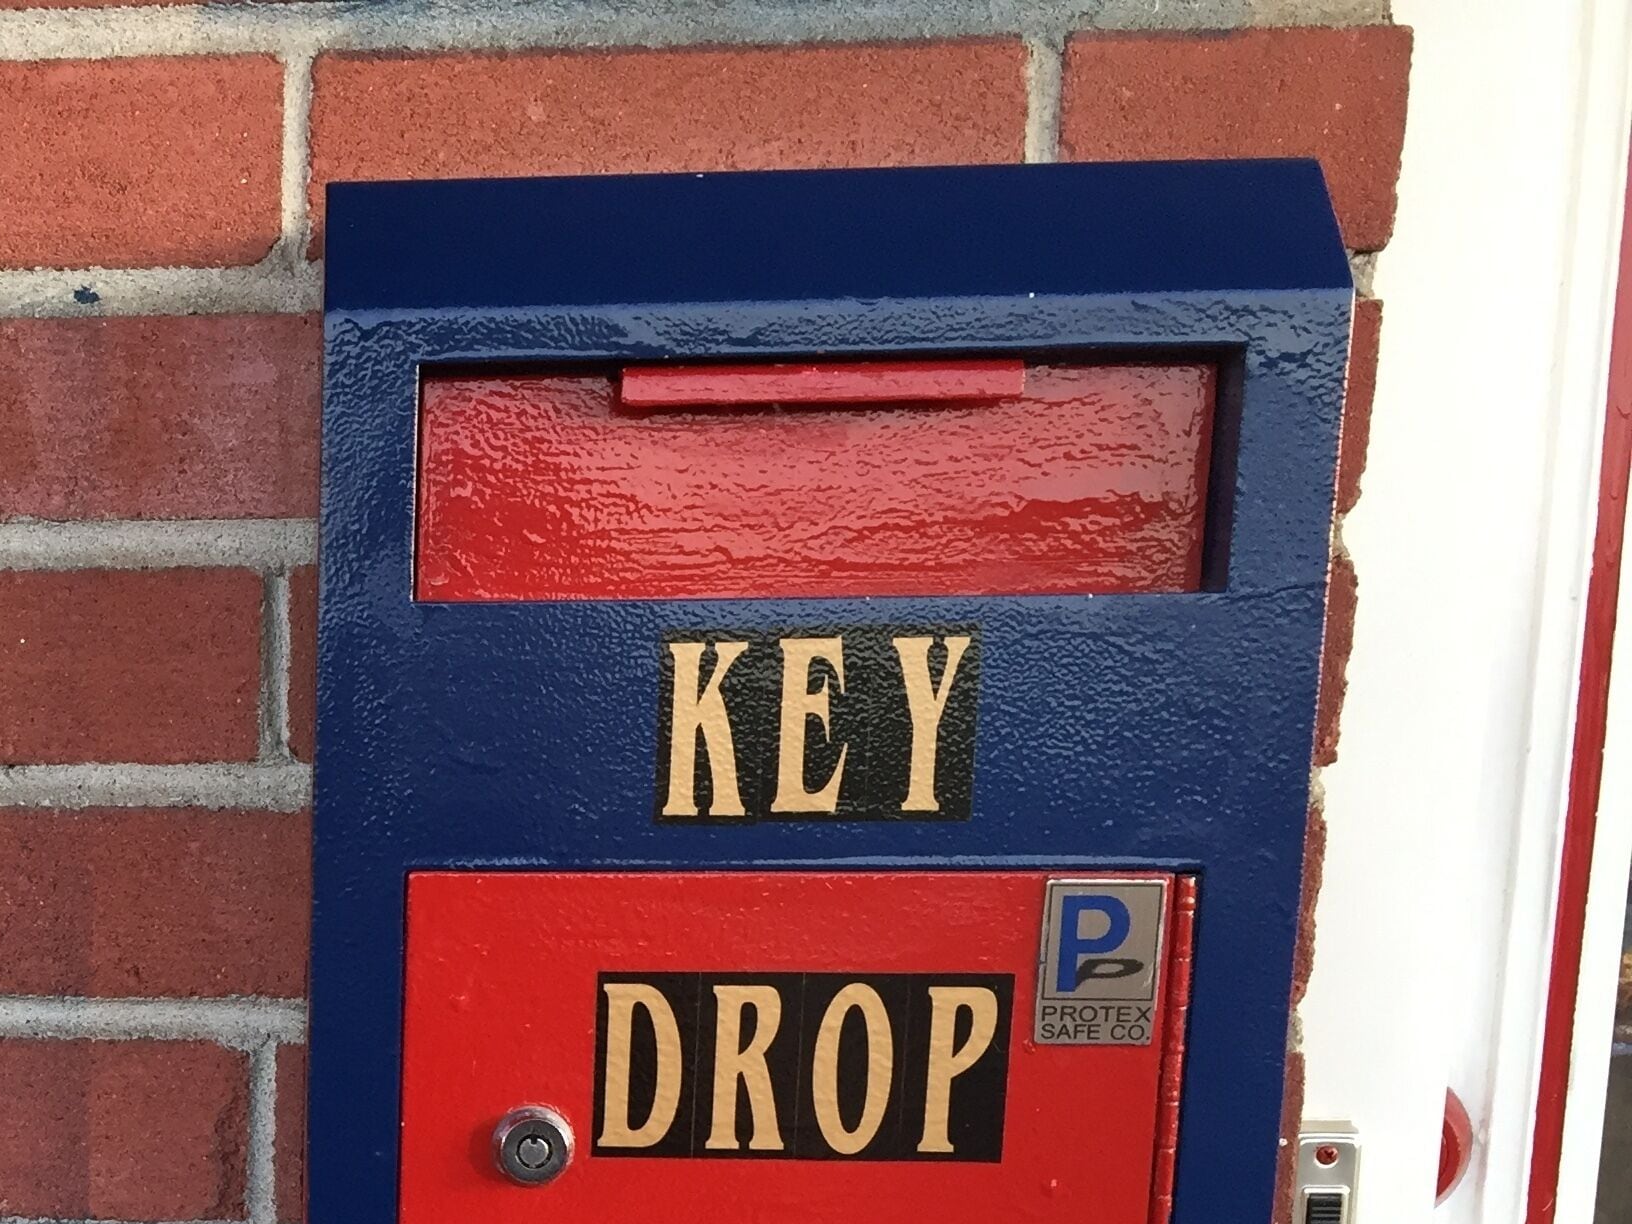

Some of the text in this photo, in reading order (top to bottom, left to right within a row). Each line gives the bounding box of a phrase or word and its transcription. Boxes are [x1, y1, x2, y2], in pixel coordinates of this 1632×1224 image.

[661, 635, 971, 817] KEY
[1040, 1005, 1152, 1023] PROTEX
[1040, 1024, 1151, 1042] SAFE CO.
[596, 981, 999, 1156] DROP
